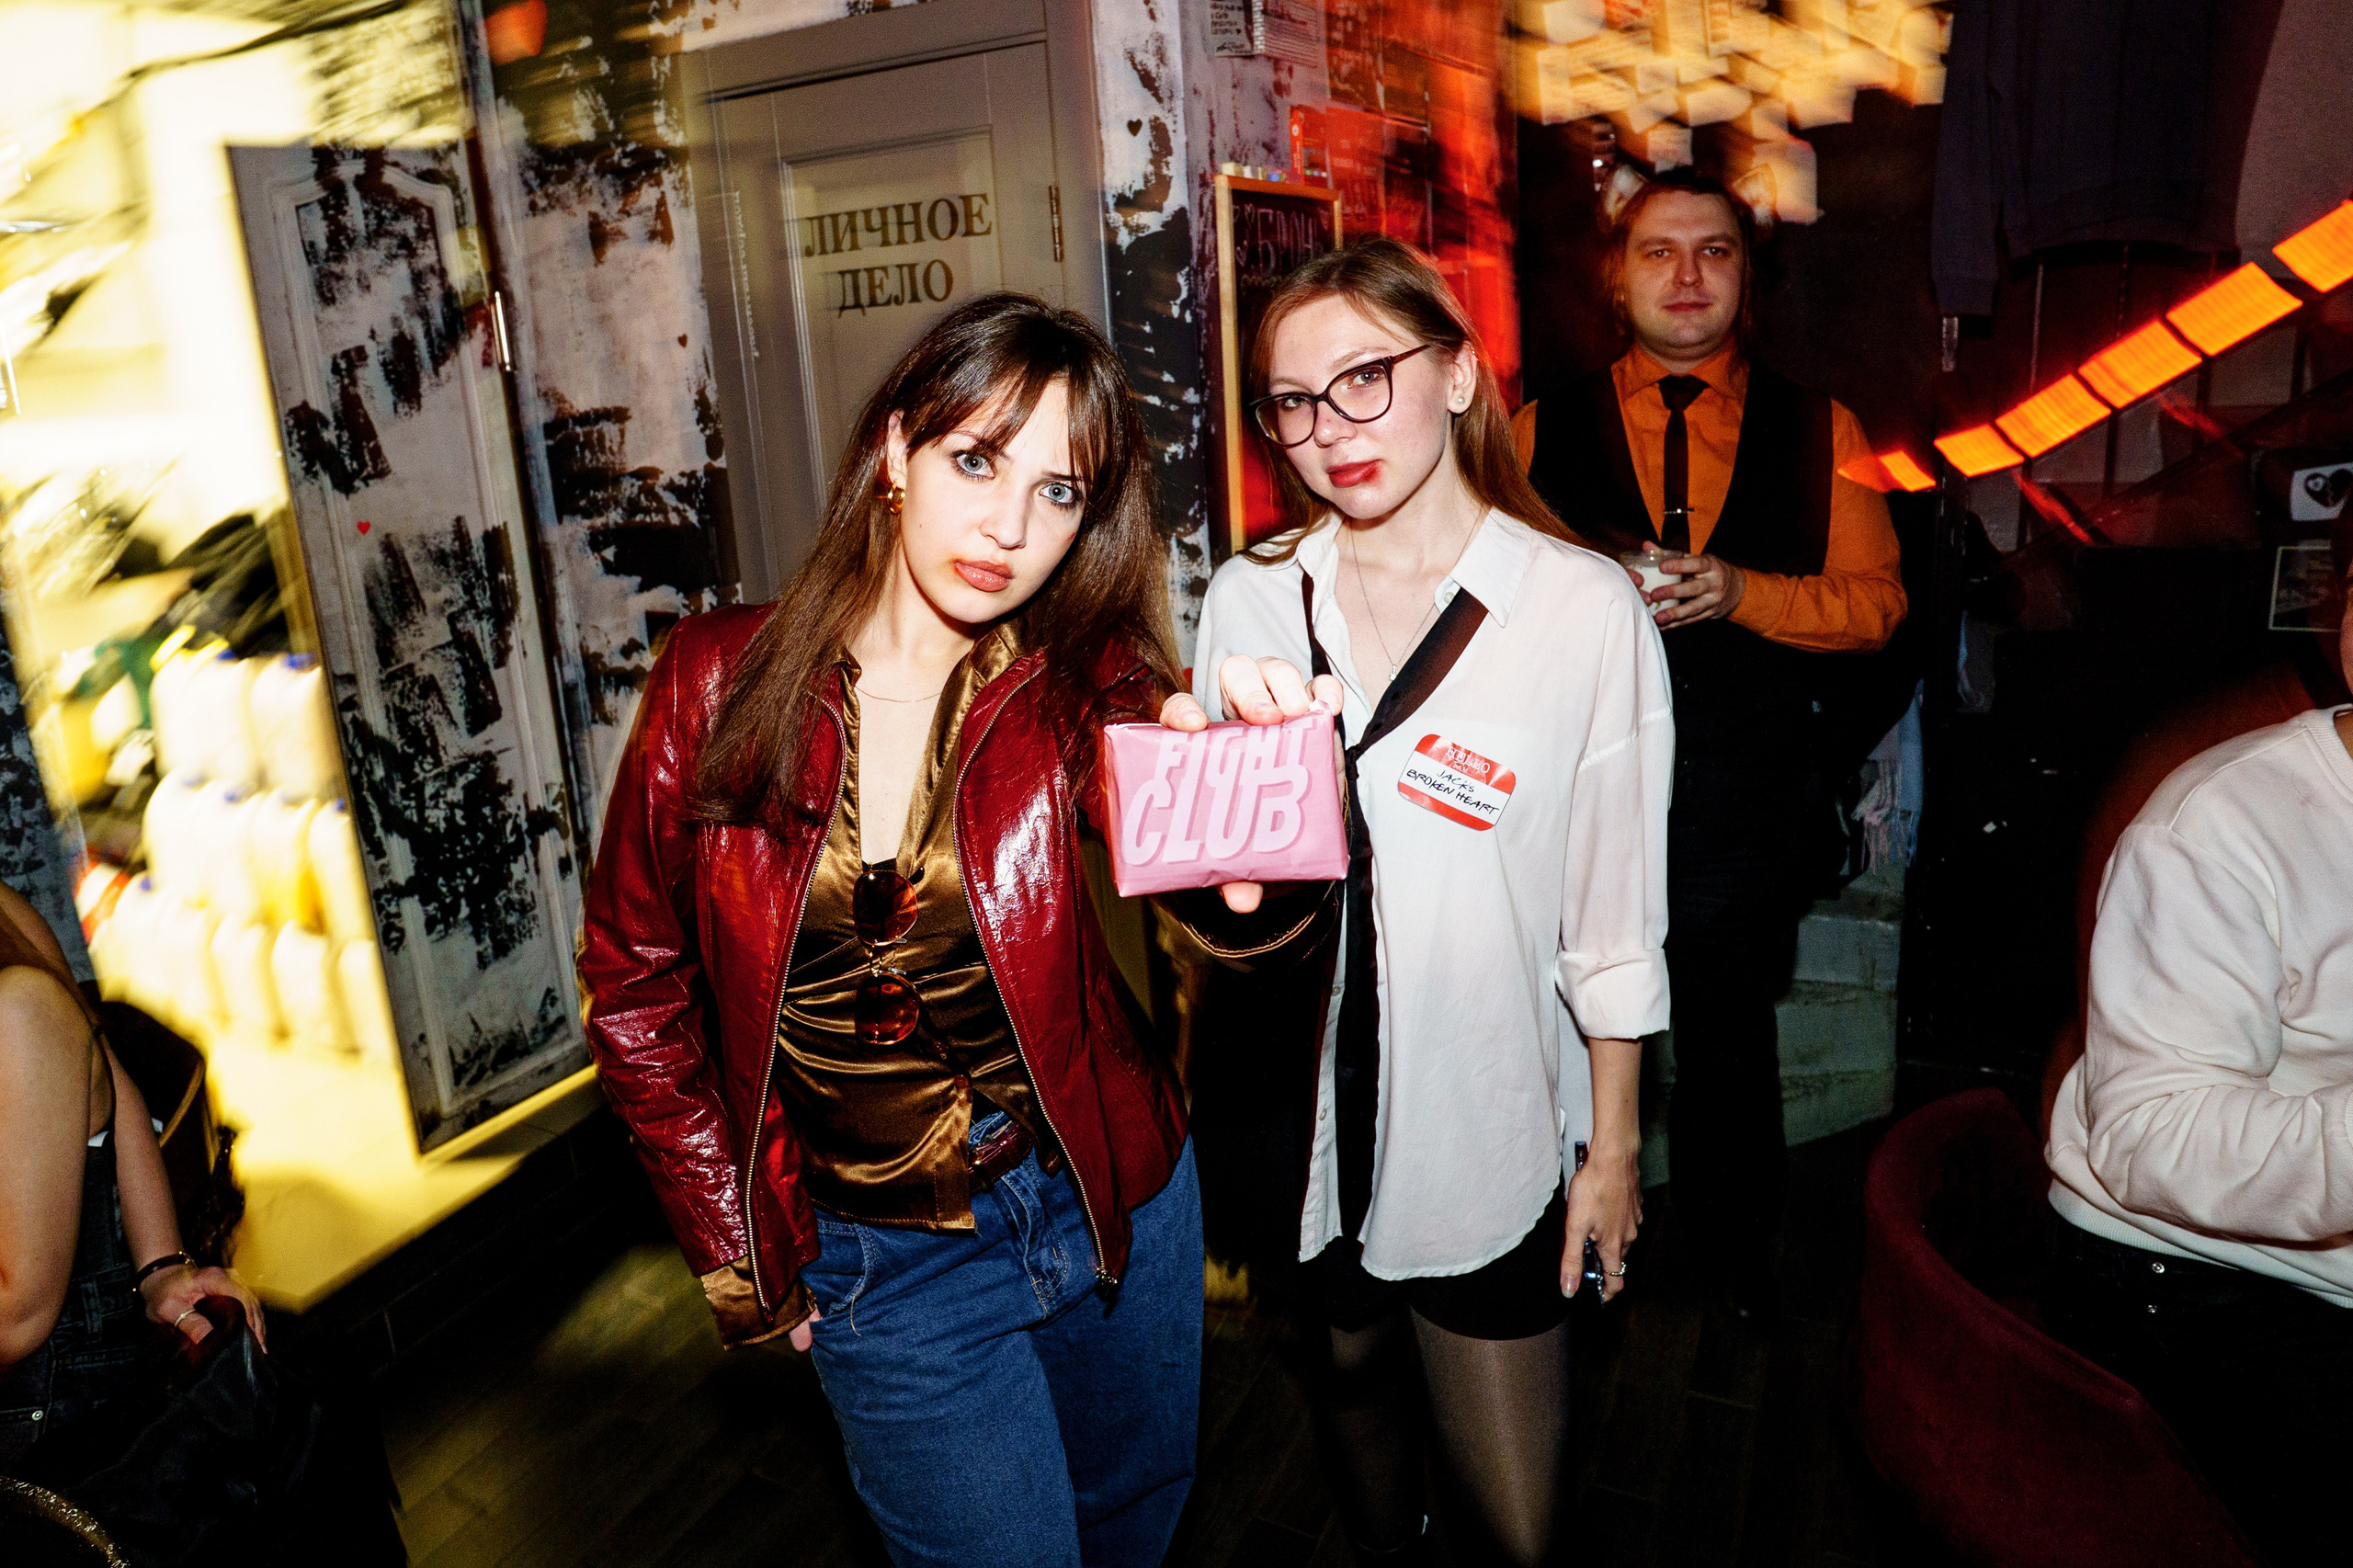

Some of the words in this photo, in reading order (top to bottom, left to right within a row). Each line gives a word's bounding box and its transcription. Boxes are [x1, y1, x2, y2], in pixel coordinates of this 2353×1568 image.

[803, 193, 993, 257] ЛИЧНОЕ
[837, 258, 954, 318] ДЕЛО
[1154, 718, 1318, 786] FIGHT
[1445, 747, 1491, 774] HELLO
[1121, 766, 1313, 866] CLUB
[1406, 768, 1455, 795] BROKEN
[1455, 791, 1500, 815] HEART
